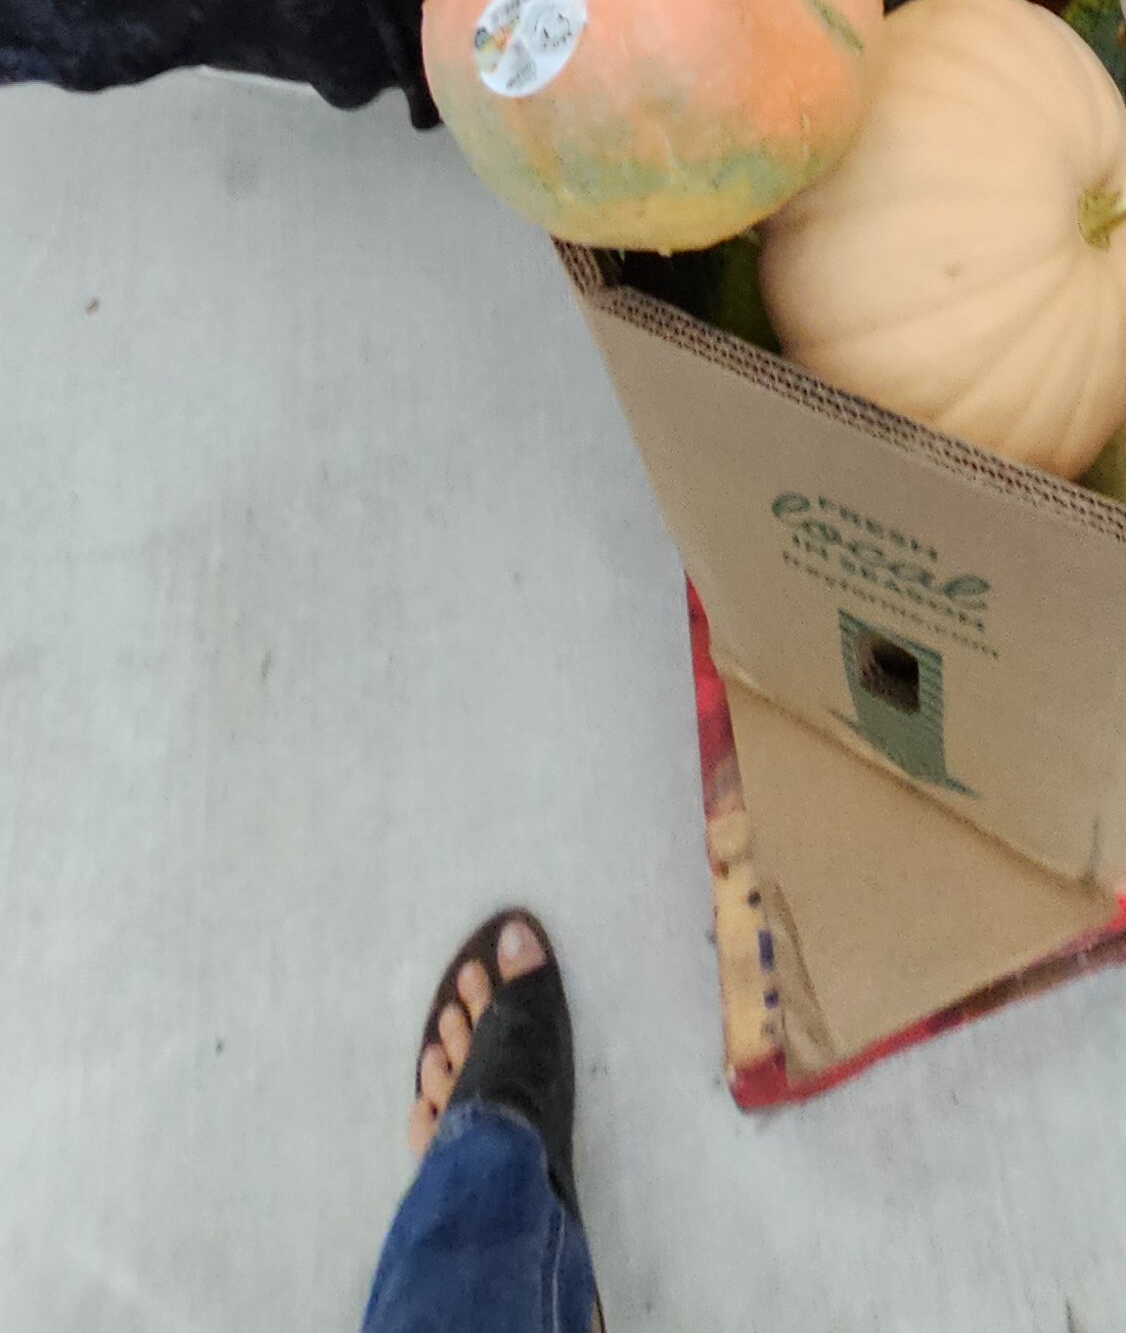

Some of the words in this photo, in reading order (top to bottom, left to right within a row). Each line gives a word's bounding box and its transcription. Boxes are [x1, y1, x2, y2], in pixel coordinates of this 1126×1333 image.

[817, 495, 939, 563] FRESH
[791, 532, 829, 562] IN
[838, 555, 985, 632] SEASON
